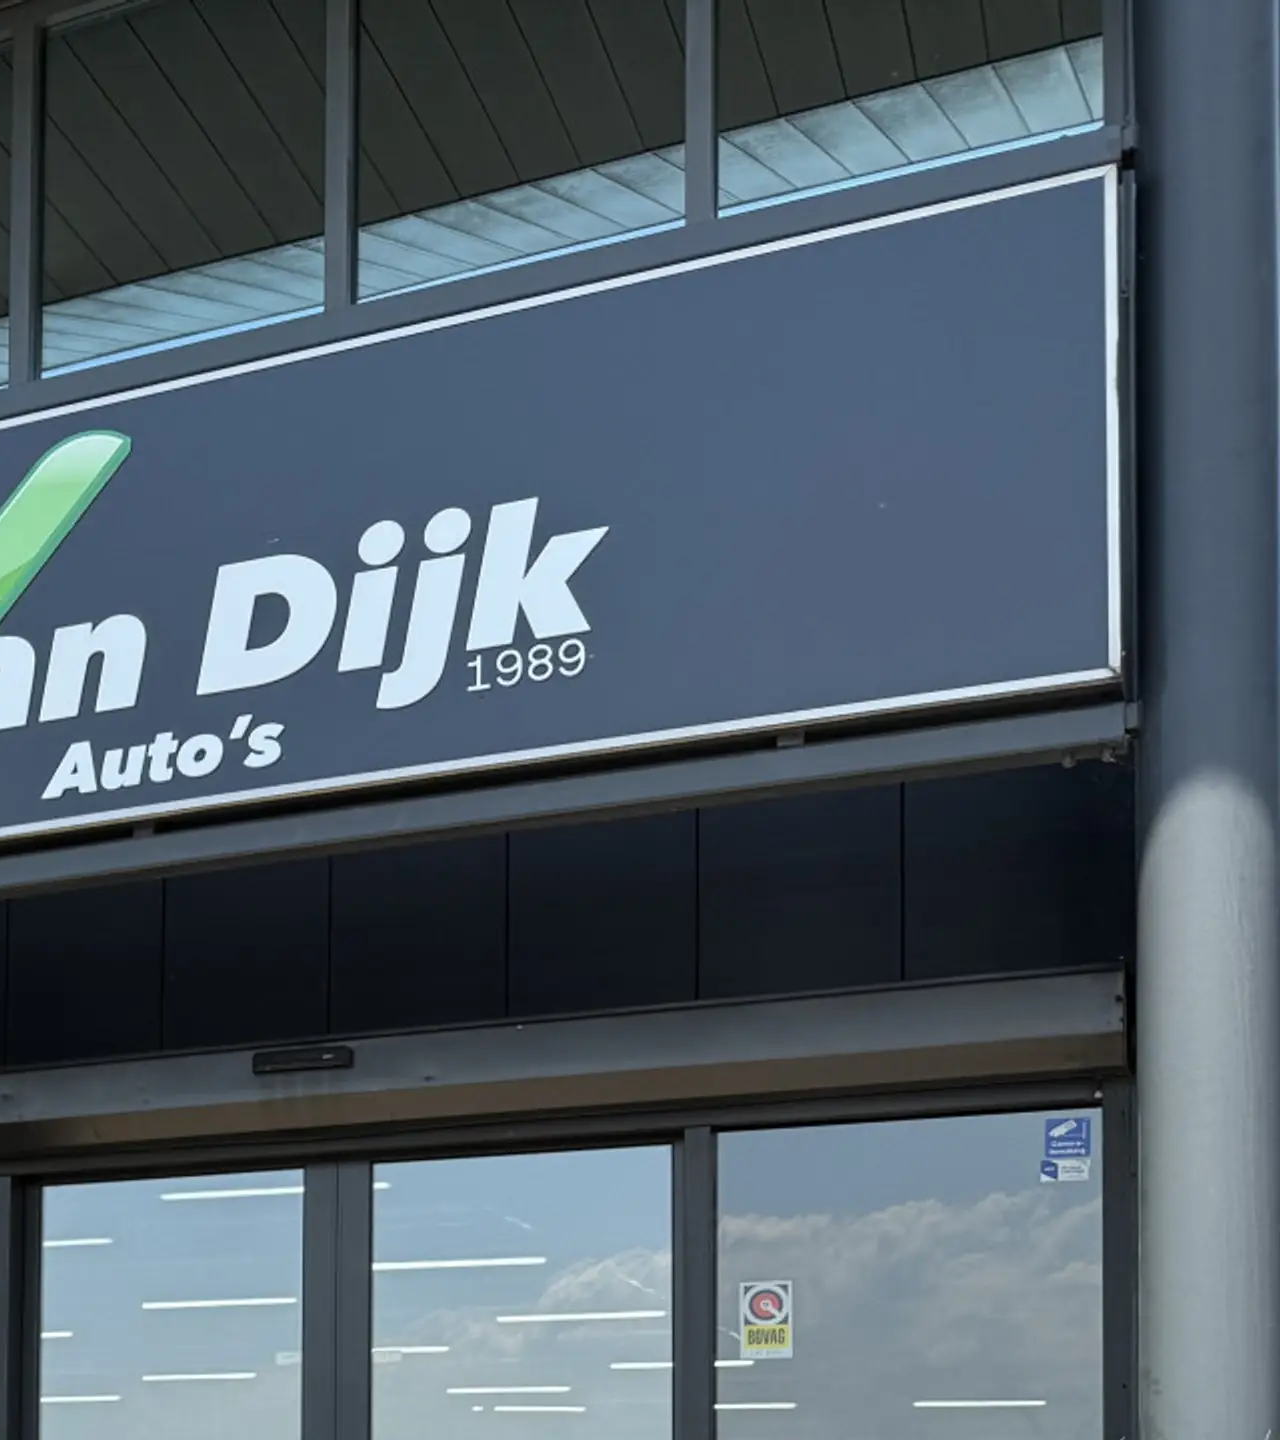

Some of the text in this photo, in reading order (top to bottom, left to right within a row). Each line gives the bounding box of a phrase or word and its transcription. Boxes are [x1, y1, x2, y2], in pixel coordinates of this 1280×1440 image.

[196, 496, 610, 710] Dijk
[466, 638, 587, 692] 1989
[41, 713, 285, 800] Auto's
[747, 1327, 786, 1346] BOVAG
